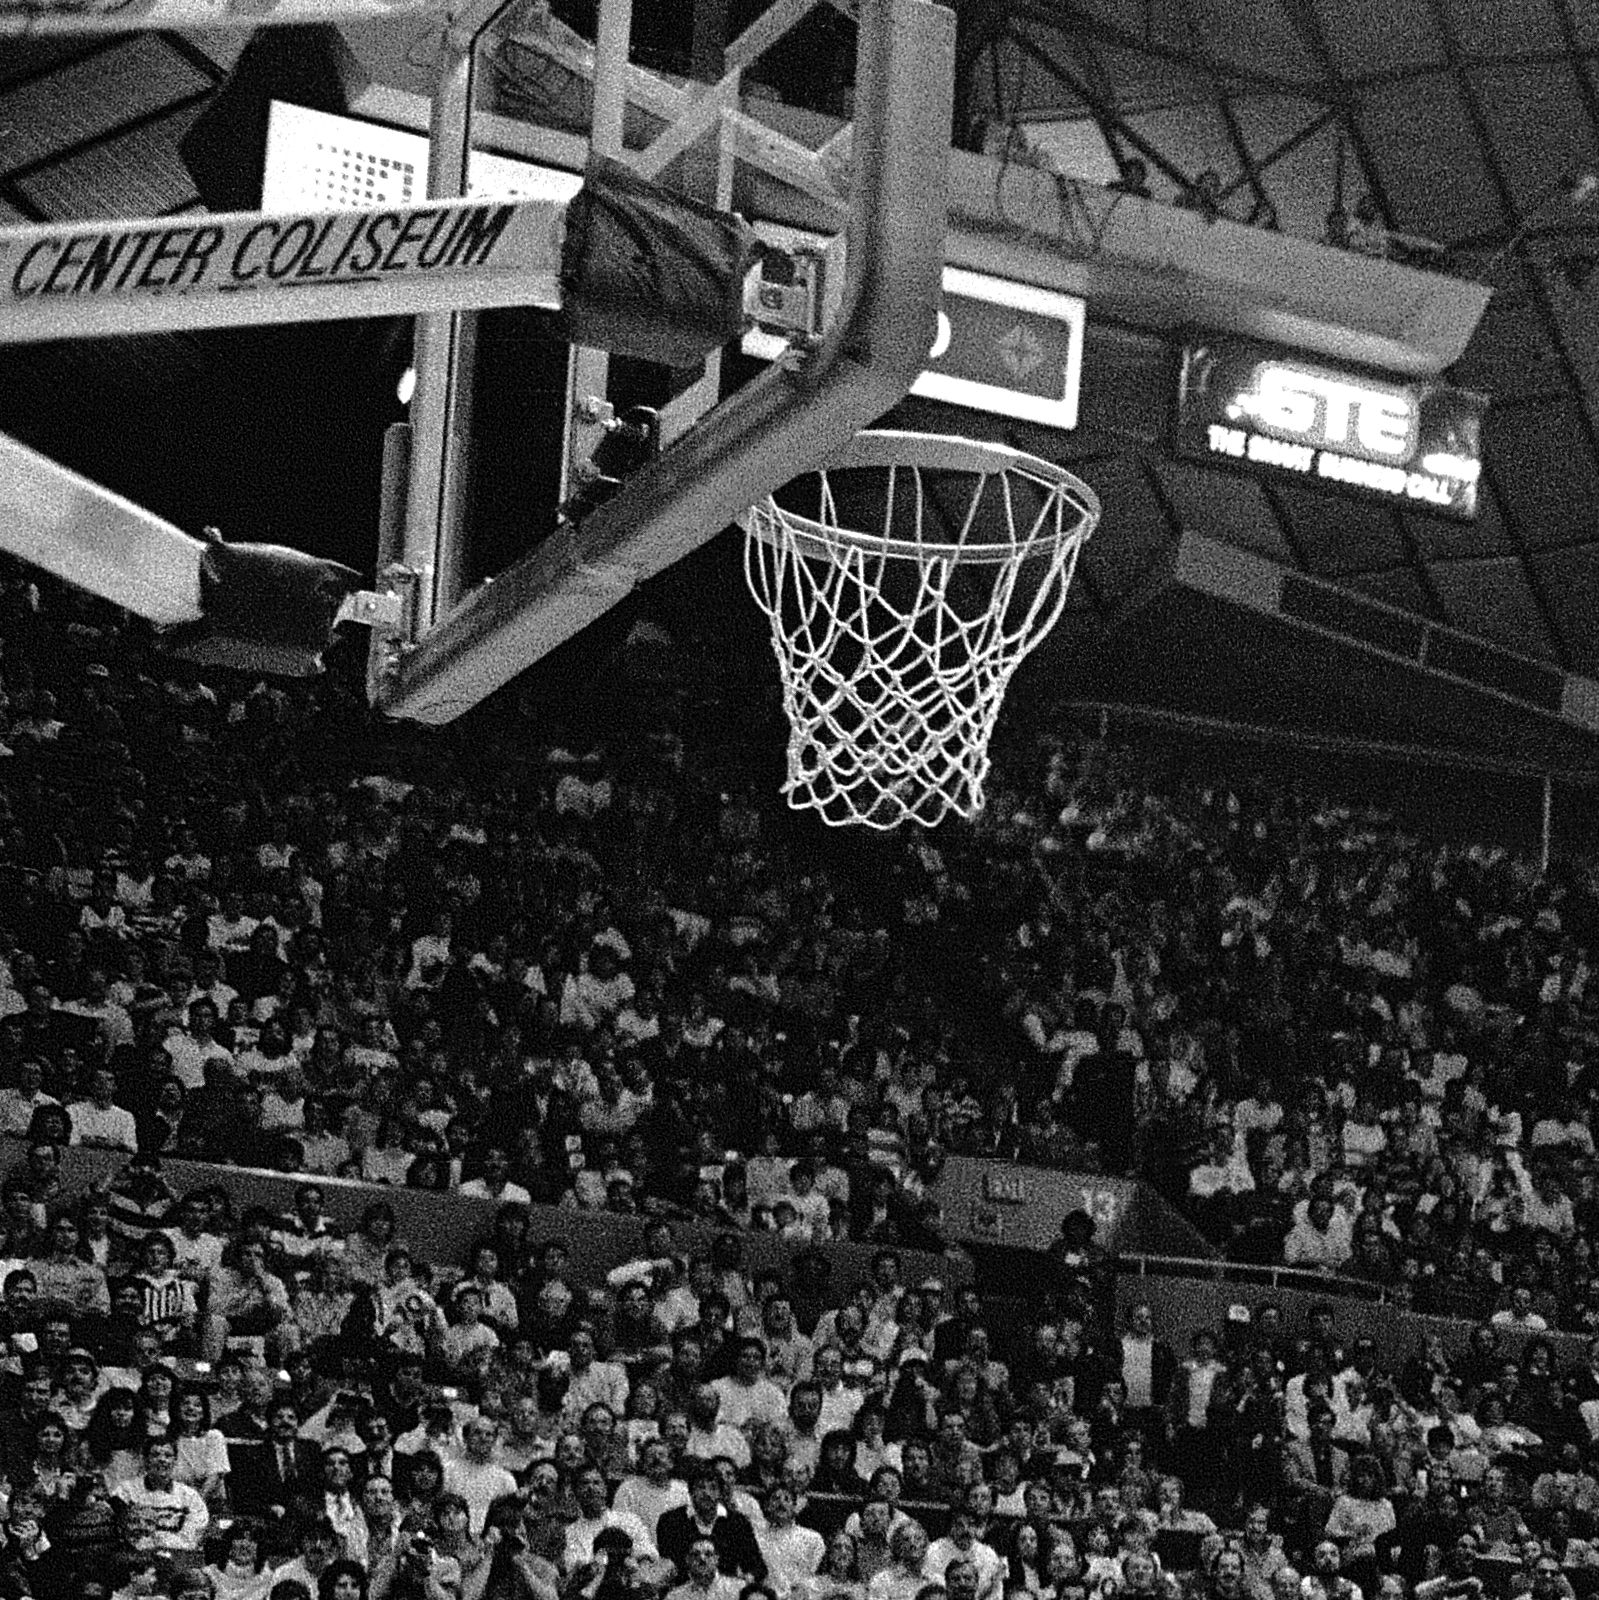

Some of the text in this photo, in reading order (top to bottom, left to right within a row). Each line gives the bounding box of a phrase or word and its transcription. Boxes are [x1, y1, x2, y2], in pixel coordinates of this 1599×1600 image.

[11, 203, 517, 296] CENTER COLISEUM
[1080, 1188, 1117, 1222] 13
